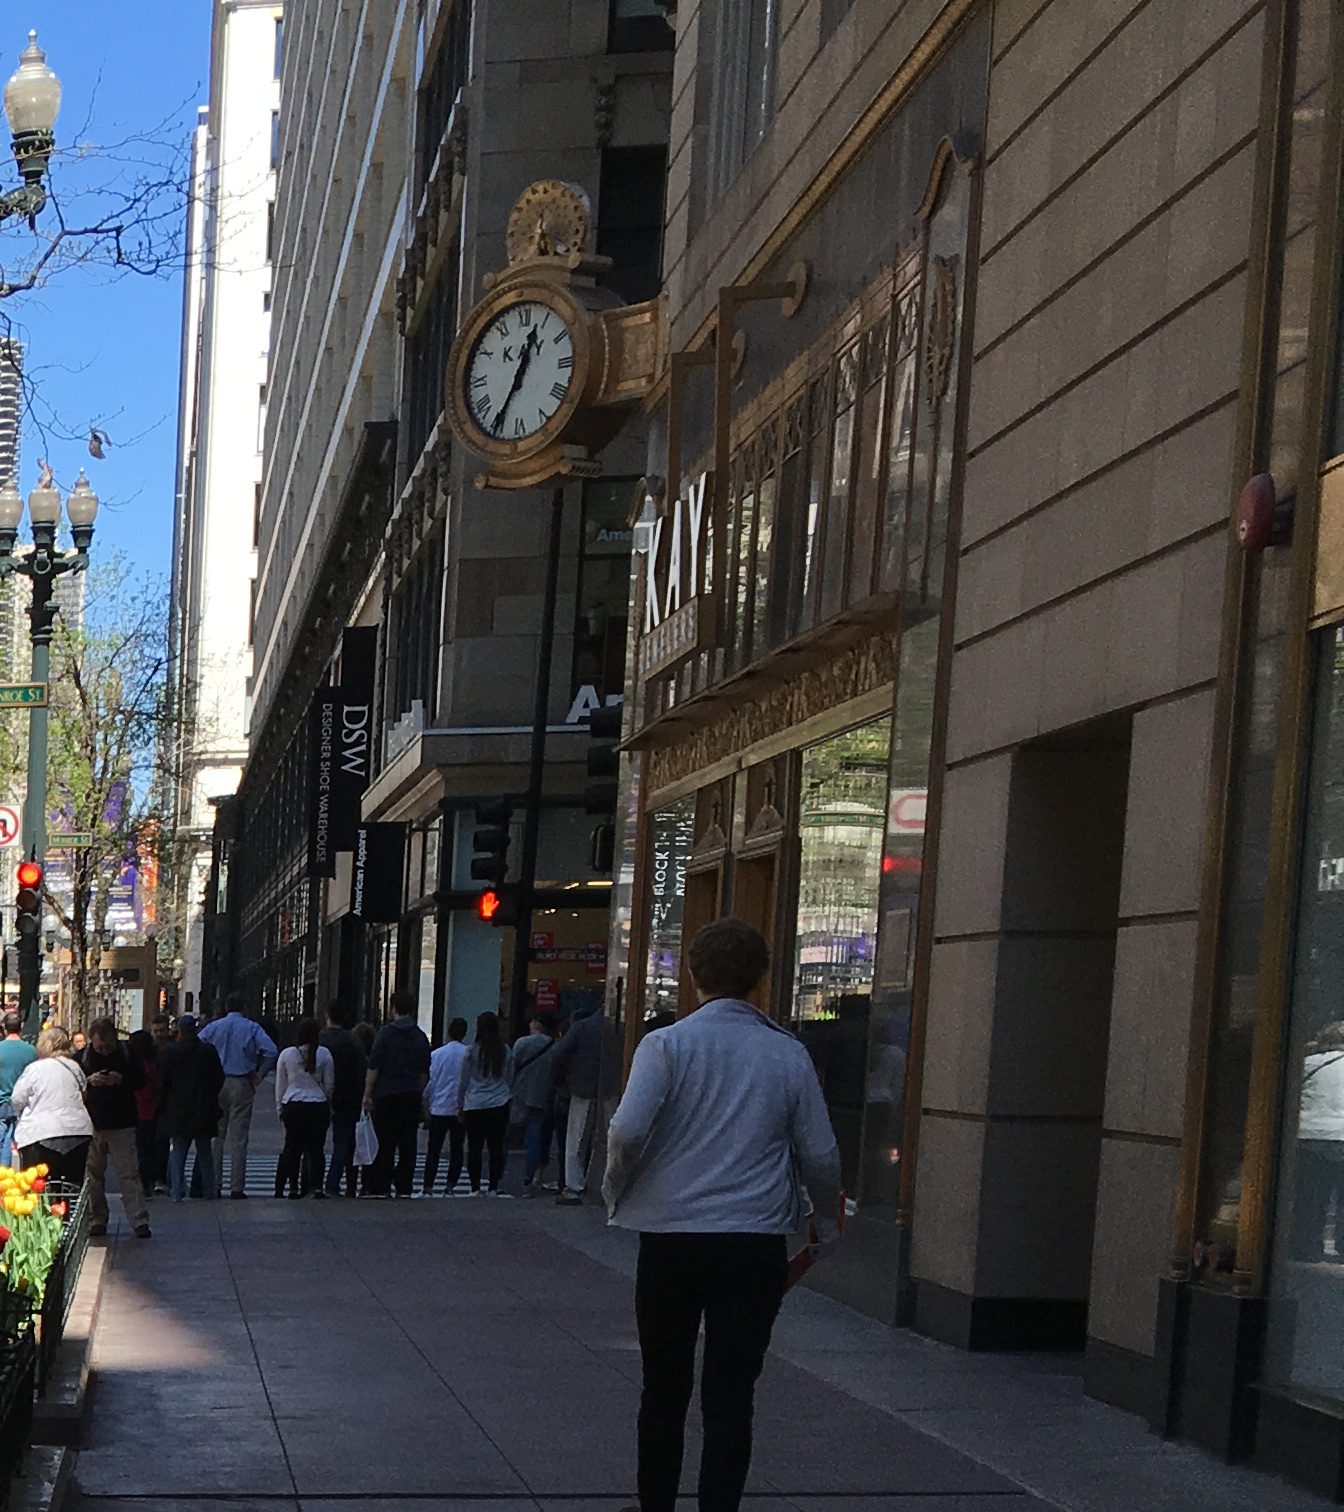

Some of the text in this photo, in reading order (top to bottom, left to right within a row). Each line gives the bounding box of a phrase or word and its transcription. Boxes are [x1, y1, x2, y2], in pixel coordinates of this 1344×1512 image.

[645, 472, 707, 634] KAY
[316, 703, 333, 863] DESIGNER SHOE WAREHOUSE
[340, 703, 369, 777] DSW
[353, 829, 367, 916] American Apparel
